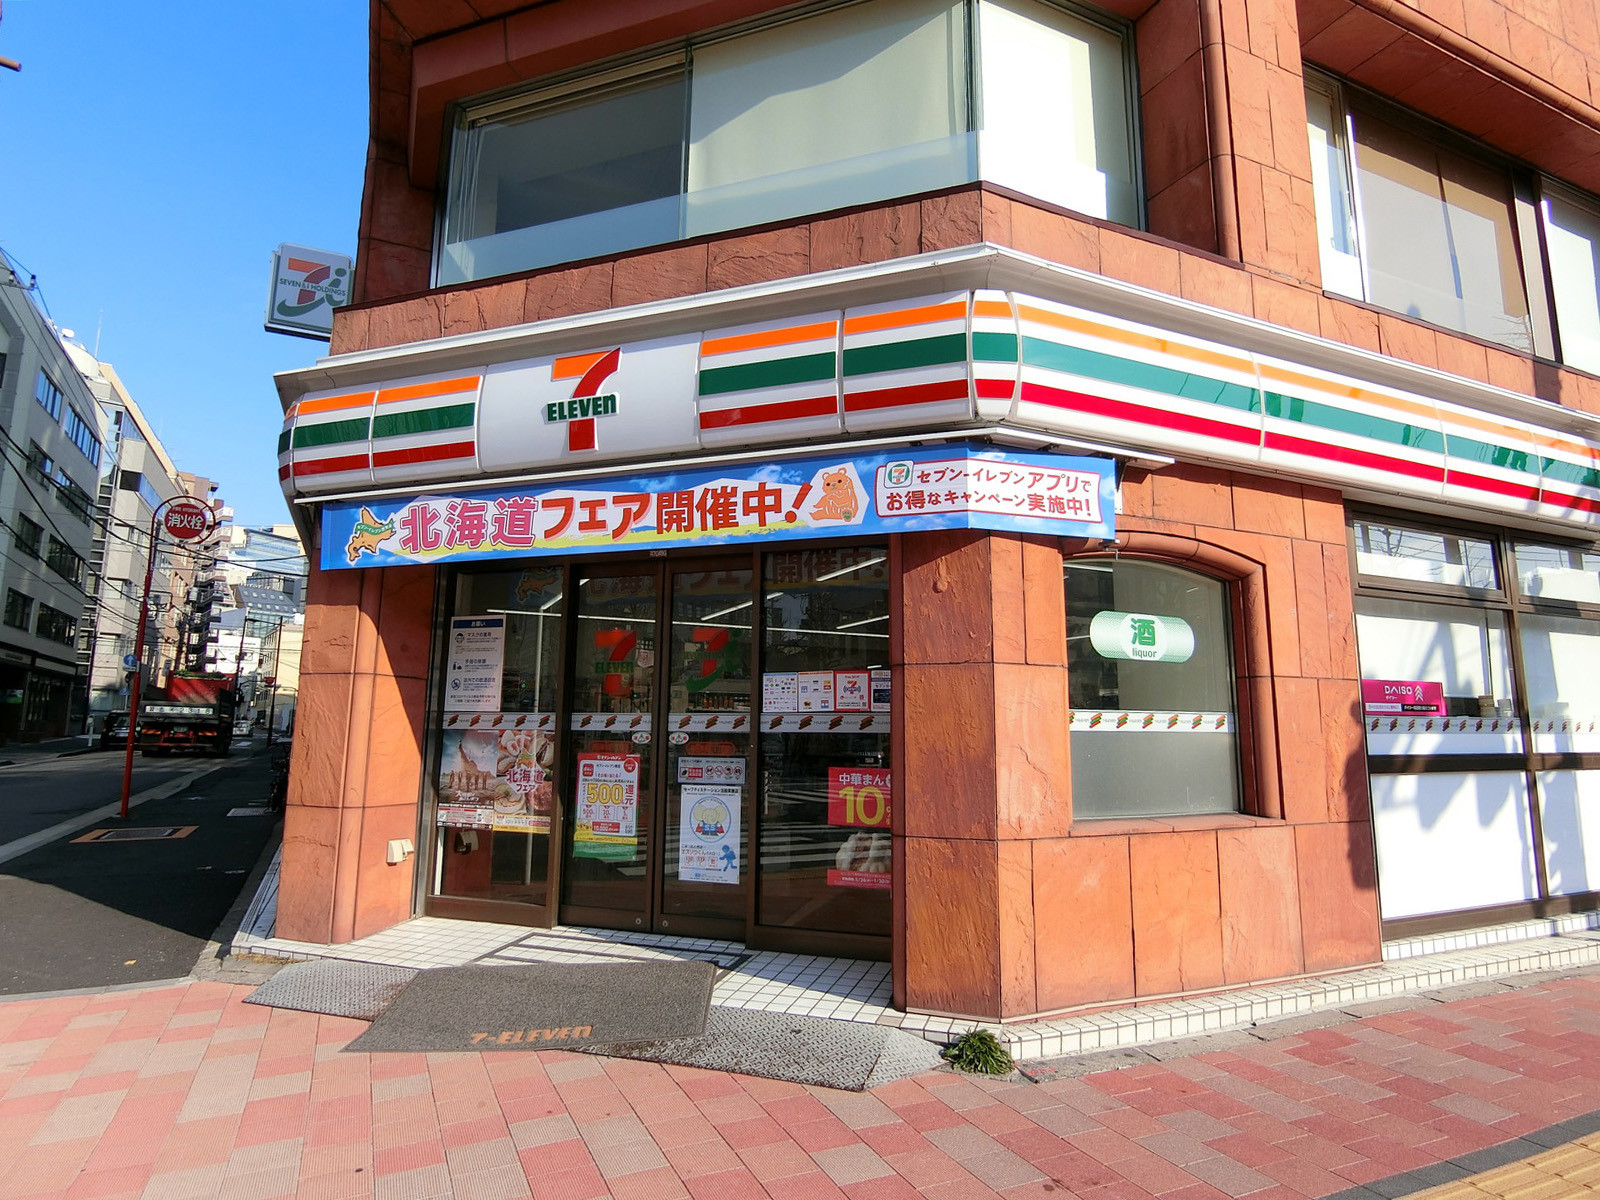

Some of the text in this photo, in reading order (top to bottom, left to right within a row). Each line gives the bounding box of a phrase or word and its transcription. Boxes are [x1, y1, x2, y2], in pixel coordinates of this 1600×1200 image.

[279, 278, 301, 288] SEVEN
[310, 284, 346, 297] HOLDINGS
[886, 489, 1092, 518] お得なキャンペーン実施中!
[167, 512, 204, 530] 消火栓
[1130, 617, 1156, 647] 酒
[1131, 647, 1158, 659] liquor
[1384, 685, 1413, 695] DAISO
[506, 769, 544, 784] 北海道
[516, 783, 536, 793] フェア
[586, 782, 624, 805] 500
